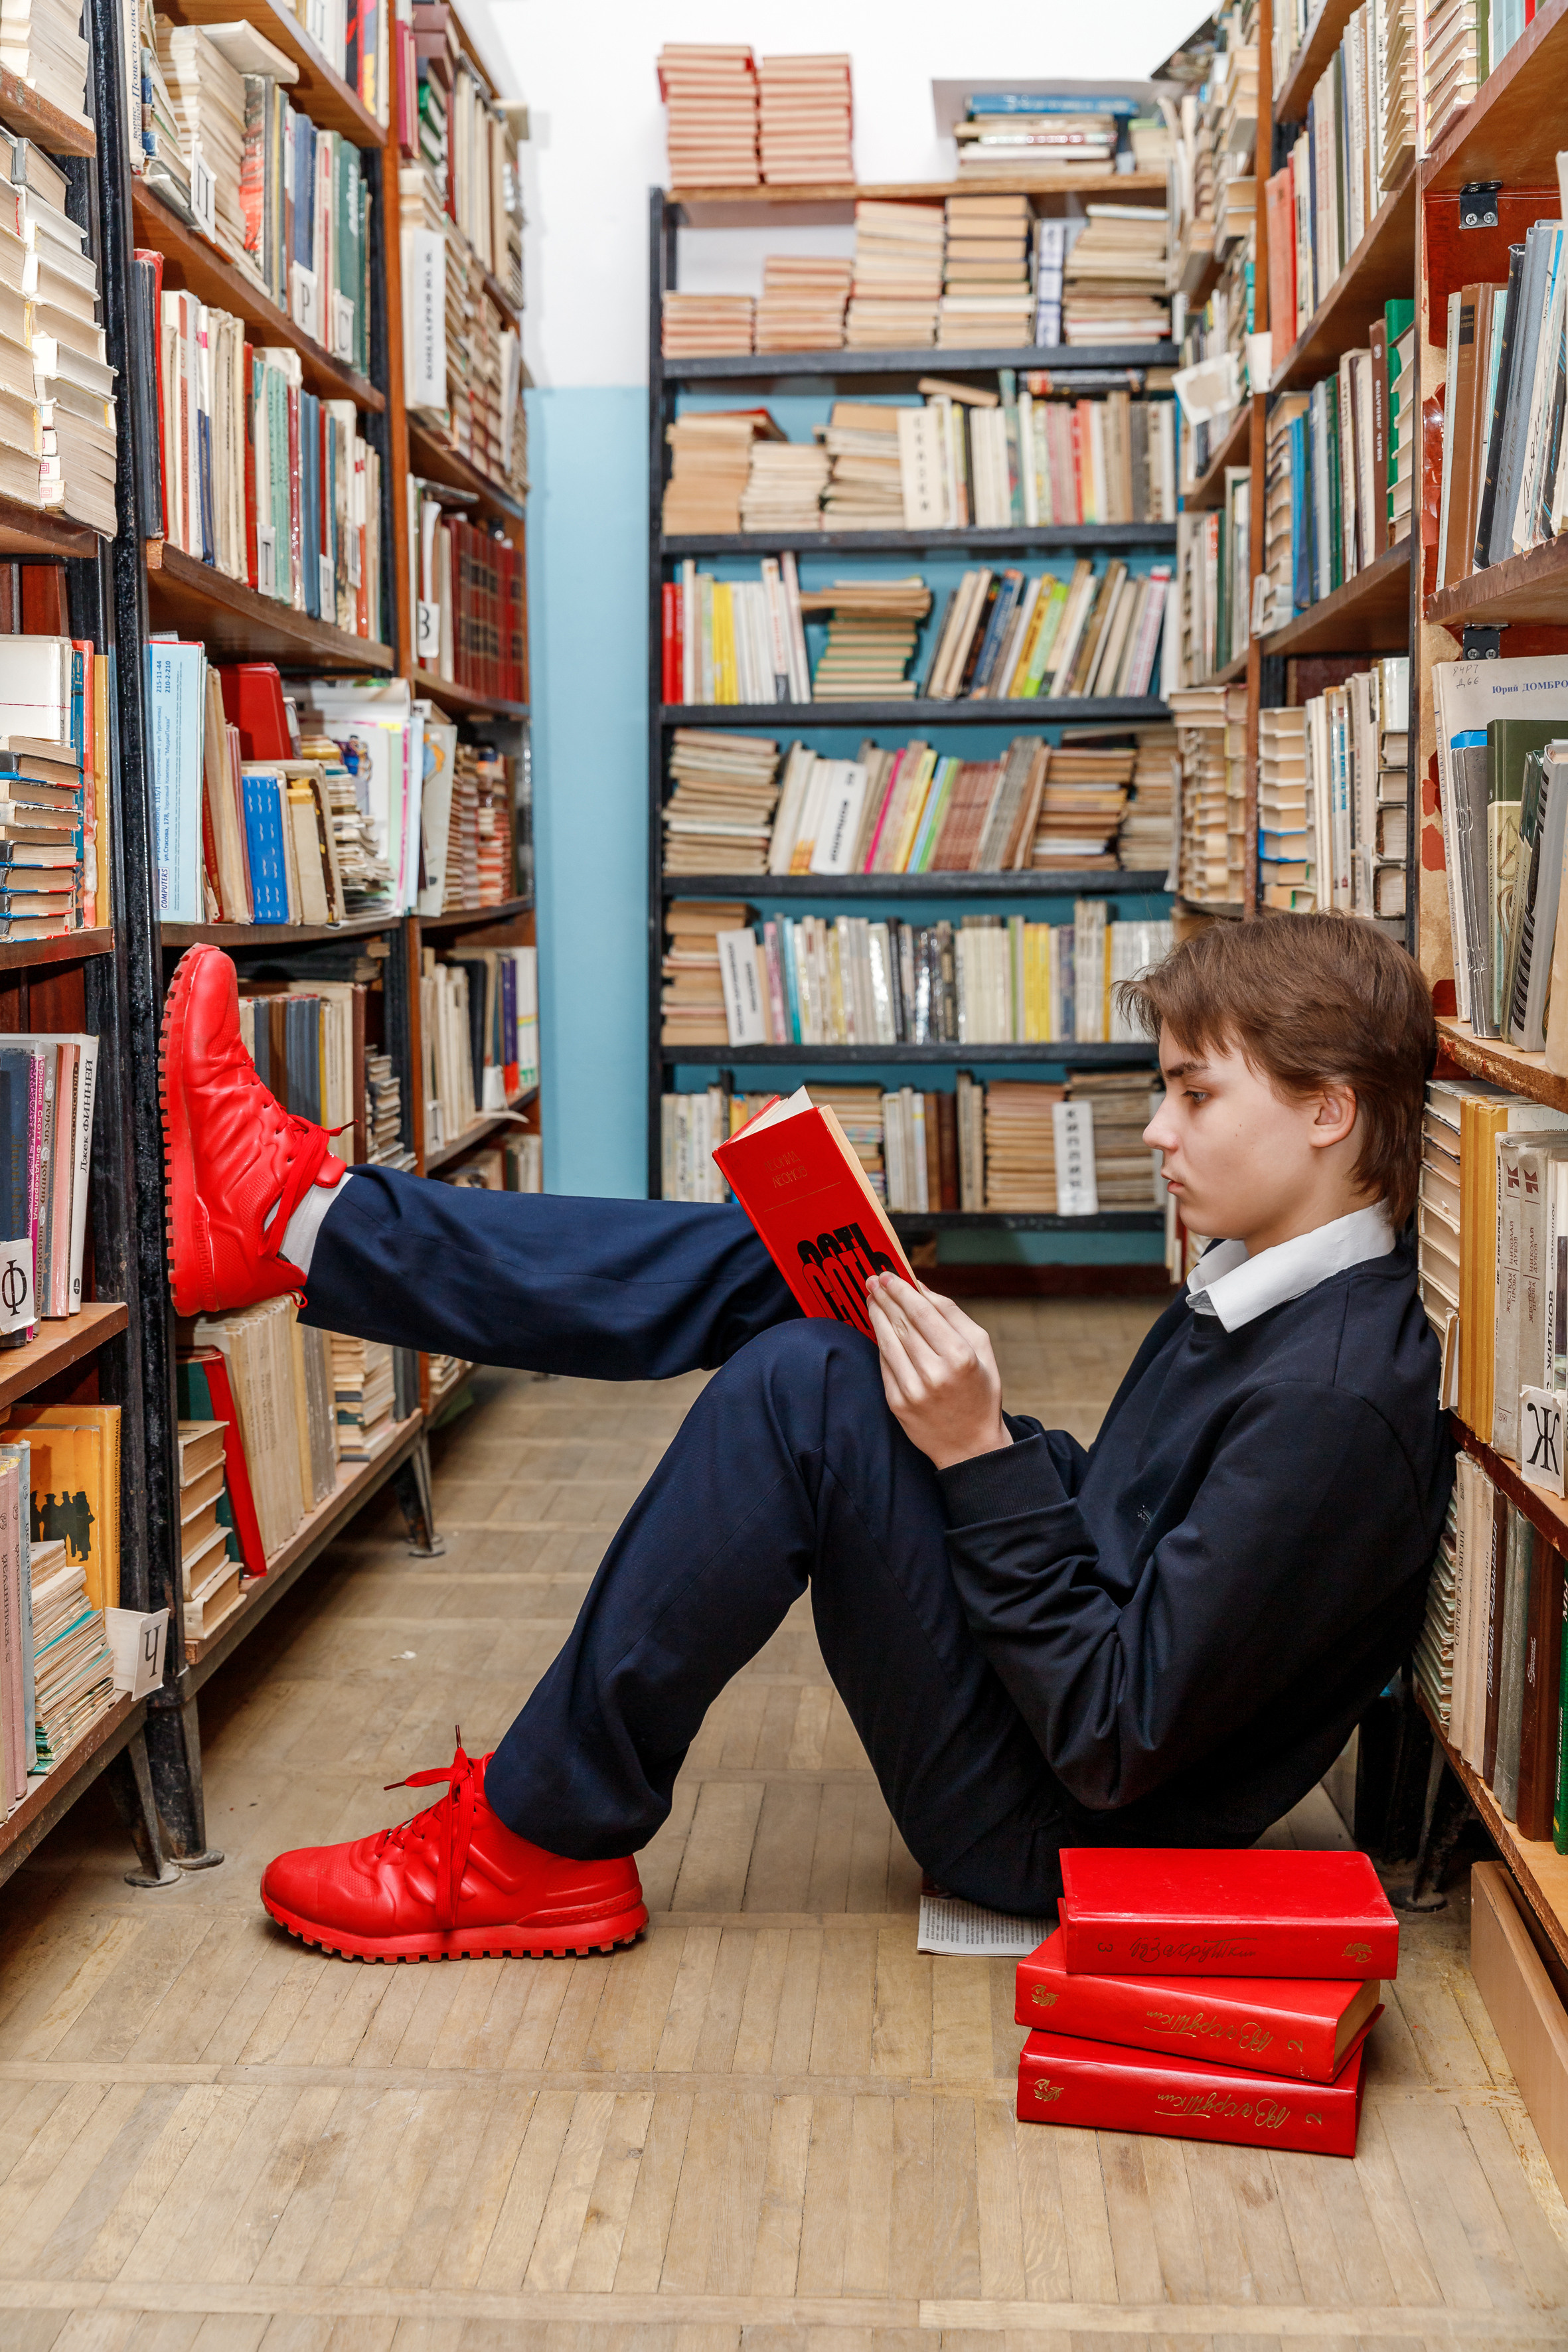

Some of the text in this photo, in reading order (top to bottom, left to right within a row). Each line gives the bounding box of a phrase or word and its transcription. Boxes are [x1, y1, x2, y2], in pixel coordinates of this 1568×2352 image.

[1492, 684, 1519, 695] Юрий
[80, 1059, 93, 1174] Джек ФИННЕЙ
[33, 1144, 42, 1220] Фицджеральд
[772, 1165, 808, 1188] ЛЕОНОВ
[1, 1259, 27, 1317] Ф
[1526, 1403, 1561, 1476] Ж
[1, 1552, 10, 1648] ХЕМИНГУЭЙ
[144, 1624, 162, 1678] Ч
[1097, 1942, 1114, 1953] 3
[1287, 2038, 1304, 2053] 2
[1305, 2112, 1320, 2126] 2
